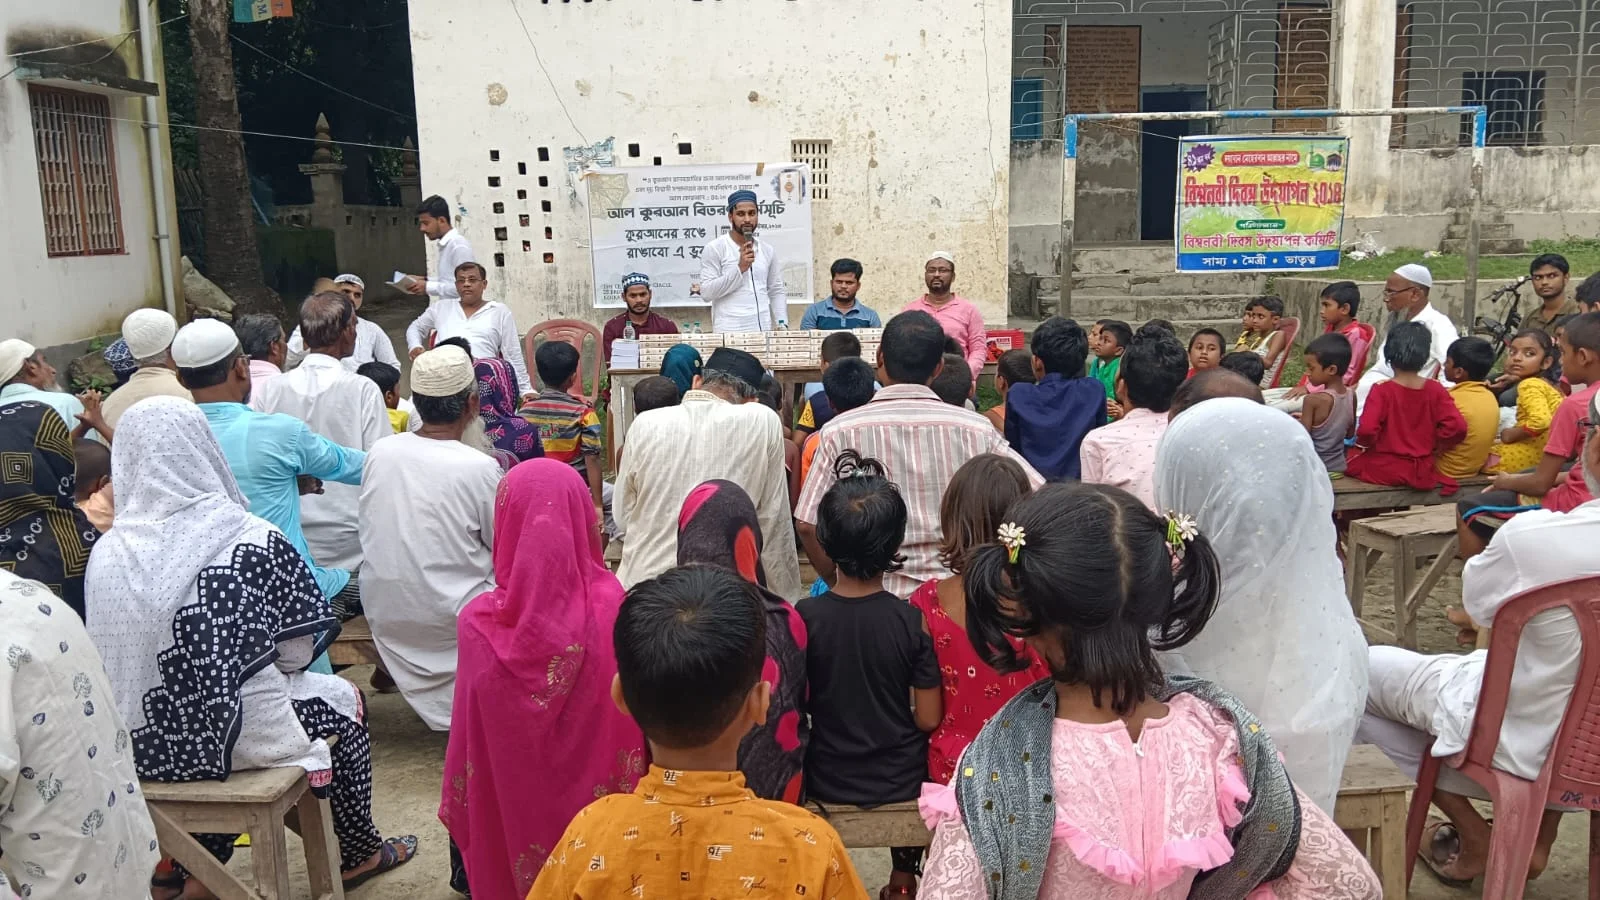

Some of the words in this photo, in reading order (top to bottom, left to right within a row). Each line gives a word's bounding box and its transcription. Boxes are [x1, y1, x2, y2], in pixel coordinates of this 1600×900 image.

[1185, 174, 1226, 207] বিশ্বনবী
[1228, 175, 1258, 206] দিবস
[1313, 182, 1343, 208] ২০১৪
[608, 207, 635, 218] আল
[639, 205, 689, 221] কুরআন
[625, 229, 679, 242] কুরআনের
[682, 227, 706, 239] রঙে
[1184, 233, 1223, 249] বিশ্বনবী
[1227, 232, 1253, 248] দিবস
[1304, 231, 1337, 246] কমিটি
[626, 246, 670, 259] রাঙাবো
[672, 246, 685, 259] এ
[1202, 256, 1228, 267] সাম্য
[1241, 253, 1267, 266] মৈত্রী
